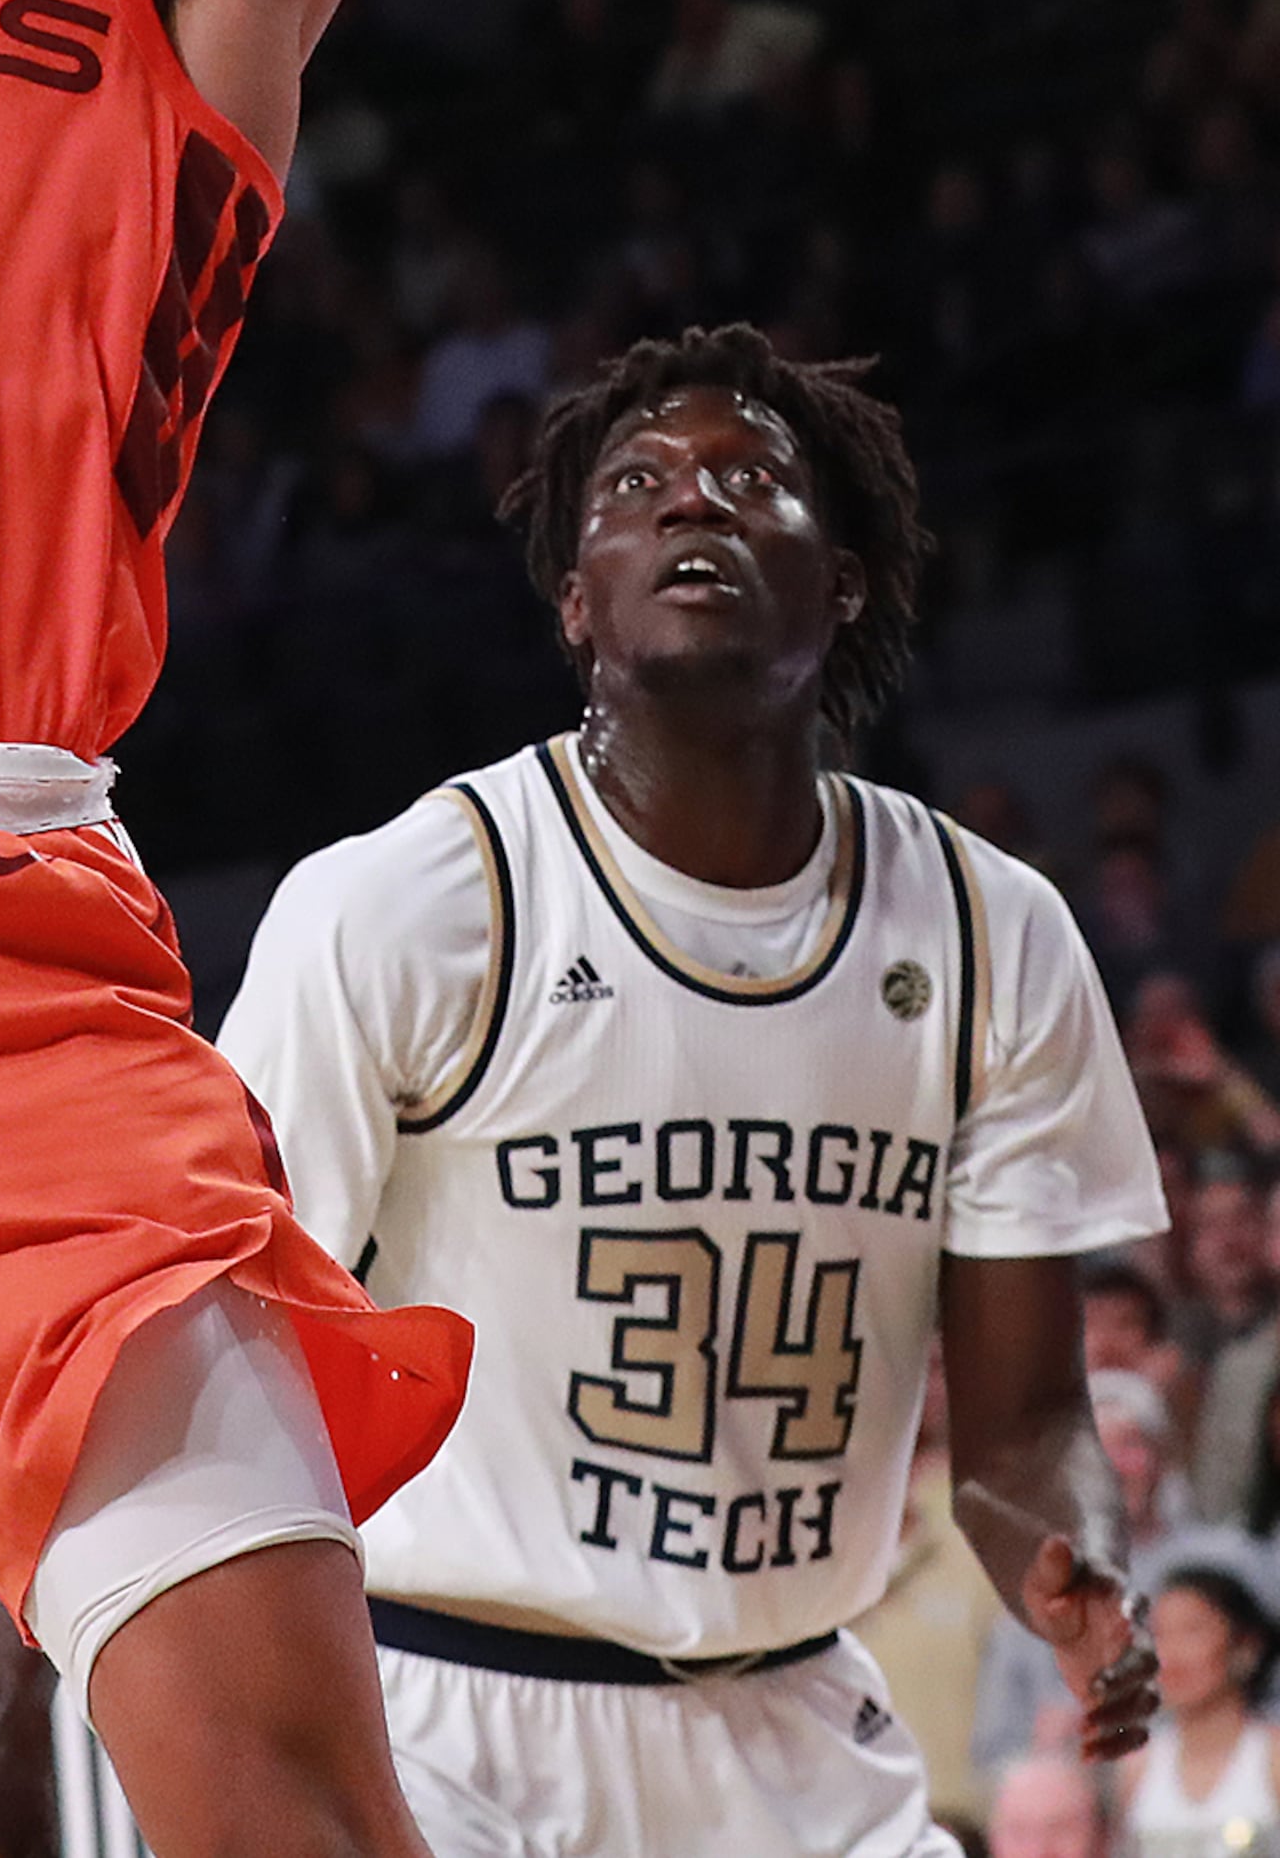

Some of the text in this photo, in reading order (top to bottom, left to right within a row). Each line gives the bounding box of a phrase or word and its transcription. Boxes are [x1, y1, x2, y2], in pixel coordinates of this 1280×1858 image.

[549, 984, 614, 1005] adidas
[495, 1118, 940, 1223] GEORGIA
[567, 1226, 864, 1464] 34
[570, 1458, 842, 1575] TECH
